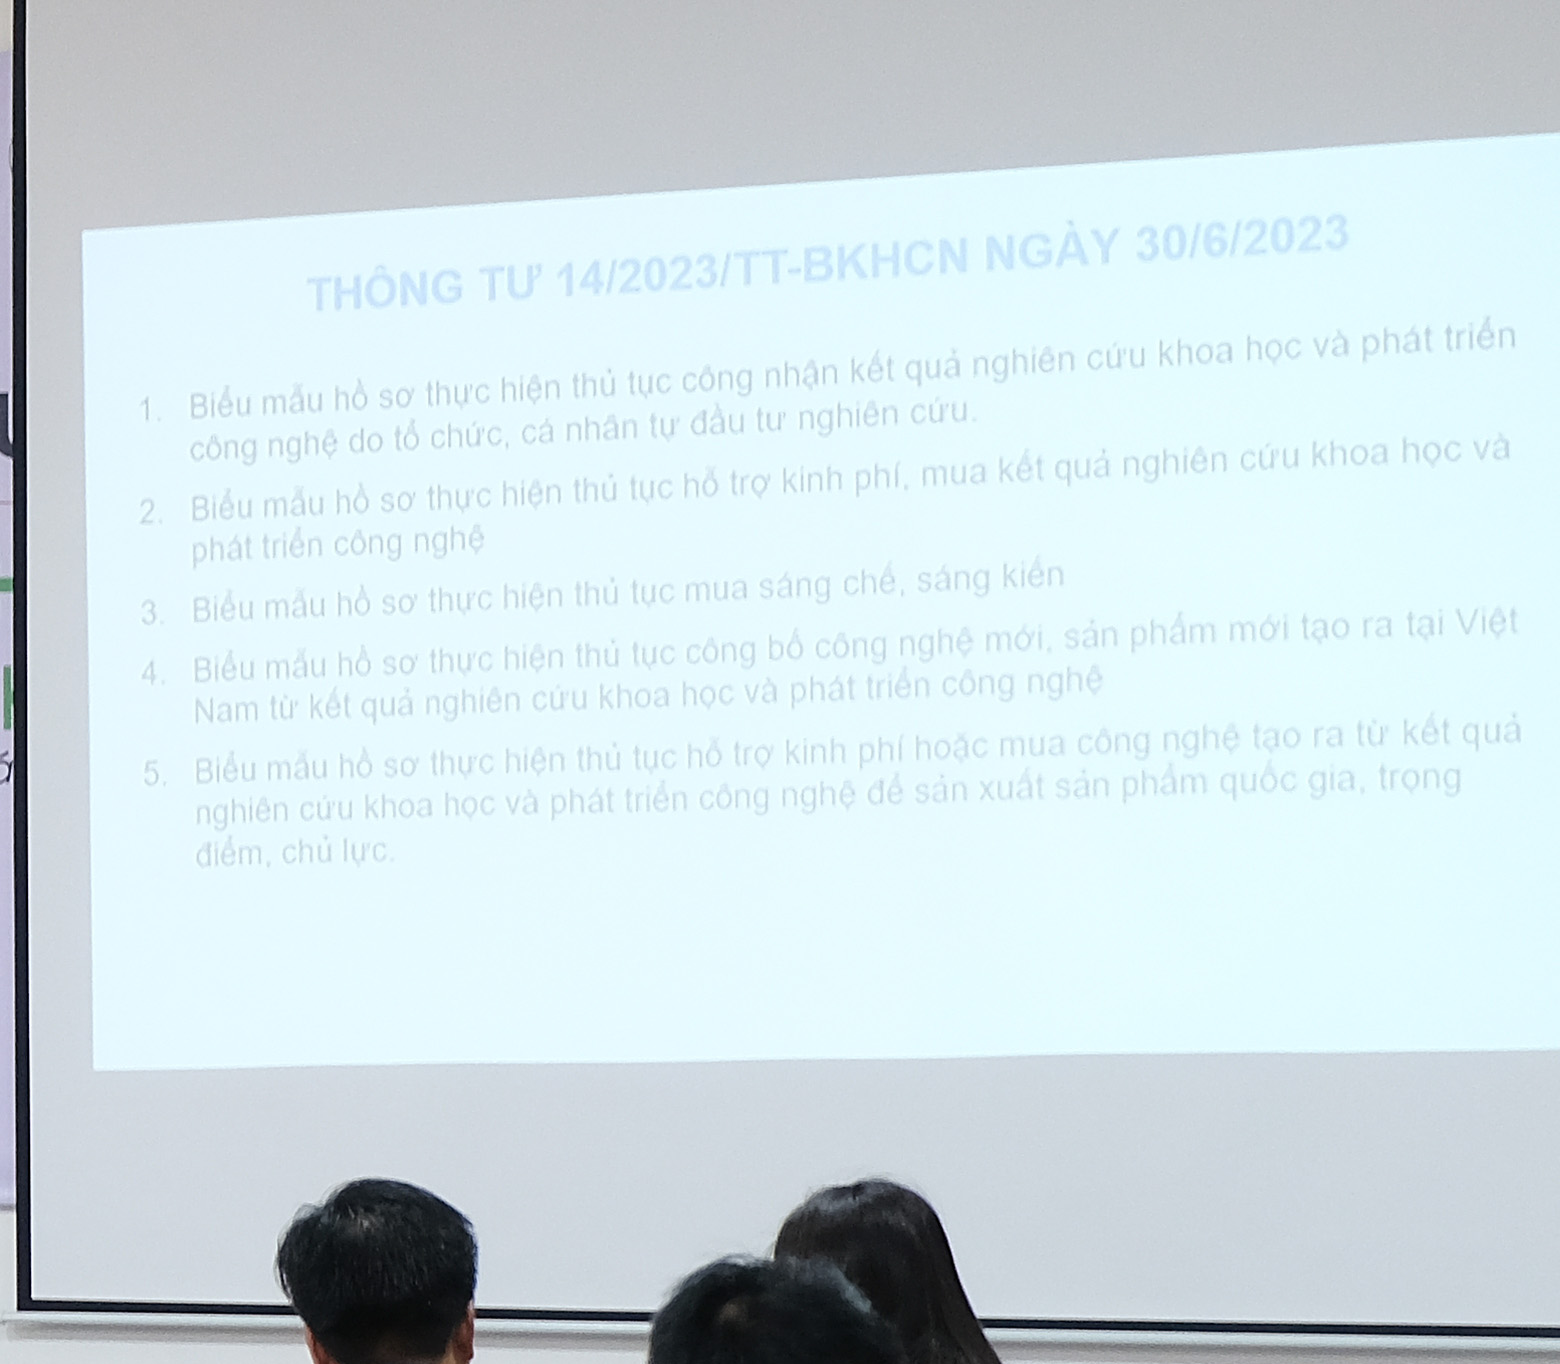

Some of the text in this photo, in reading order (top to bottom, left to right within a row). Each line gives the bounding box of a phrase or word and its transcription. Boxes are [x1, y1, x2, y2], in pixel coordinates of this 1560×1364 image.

[306, 212, 1351, 313] THÔNG TƯ 14/2023/TT-BKHCN NGÀY 30/6/2023
[190, 385, 252, 420] Biểu
[262, 383, 323, 415] mẫu
[335, 378, 369, 412] hồ
[379, 387, 415, 410] sơ
[426, 380, 491, 409] thực
[501, 374, 561, 405] hiện
[572, 367, 616, 399] thủ
[628, 370, 672, 399] tục
[682, 364, 753, 398] công
[765, 359, 839, 391] nhận
[851, 349, 895, 384] kết
[905, 348, 961, 388] quả
[973, 346, 1076, 384] nghiên
[1087, 342, 1146, 371] cứu
[1159, 338, 1234, 367] khoa
[1246, 335, 1302, 365] học
[1313, 329, 1350, 359] và
[1362, 324, 1433, 363] phát
[1444, 315, 1516, 353] triển
[190, 434, 258, 467] công
[268, 428, 339, 464] nghệ
[348, 427, 384, 454] do
[394, 418, 420, 452] tổ
[521, 418, 554, 445] cá
[566, 414, 638, 442] nhân
[649, 412, 681, 442] tự
[690, 402, 745, 436] đầu
[756, 406, 787, 433] tư
[799, 400, 899, 438] nghiên
[192, 488, 253, 522] Biểu
[263, 486, 324, 518] mẫu
[336, 482, 370, 515] hồ
[381, 491, 416, 513] sơ
[427, 484, 491, 513] thực
[502, 479, 562, 510] hiện
[573, 472, 617, 504] thủ
[629, 475, 673, 504] tục
[684, 467, 720, 498] hỗ
[730, 470, 771, 499] trợ
[783, 465, 843, 494] kinh
[922, 463, 987, 487] mua
[999, 448, 1045, 483] kết
[1054, 447, 1111, 488] quả
[1123, 446, 1228, 484] nghiên
[1240, 443, 1300, 472] cứu
[1312, 439, 1389, 468] khoa
[1402, 436, 1462, 468] học
[1473, 432, 1511, 461] và
[192, 523, 485, 570] phát triển công nghệ
[193, 589, 254, 623] Biểu
[265, 589, 325, 619] mẫu
[337, 584, 371, 617] hồ
[382, 594, 418, 615] sơ
[428, 586, 492, 615] thực
[503, 582, 563, 612] hiện
[575, 576, 619, 607] thủ
[631, 579, 675, 608] tục
[685, 579, 748, 602] mua
[759, 572, 831, 605] sáng
[917, 565, 991, 598] sáng
[1003, 555, 1065, 589] kiến
[196, 796, 289, 832] nghiên
[300, 795, 353, 821] cứu
[365, 793, 433, 819] khoa
[444, 791, 495, 820] học
[505, 789, 539, 815] và
[551, 787, 614, 821] phát
[625, 779, 688, 813] triển
[699, 783, 770, 816] công
[782, 779, 856, 815] nghệ
[867, 771, 904, 806] để
[915, 773, 968, 805] sản
[980, 767, 1044, 801] xuất
[1055, 768, 1110, 800] sản
[1122, 761, 1208, 804] phẩm
[1220, 759, 1297, 801] quốc
[1378, 763, 1461, 798] trọng
[282, 834, 333, 865] chủ
